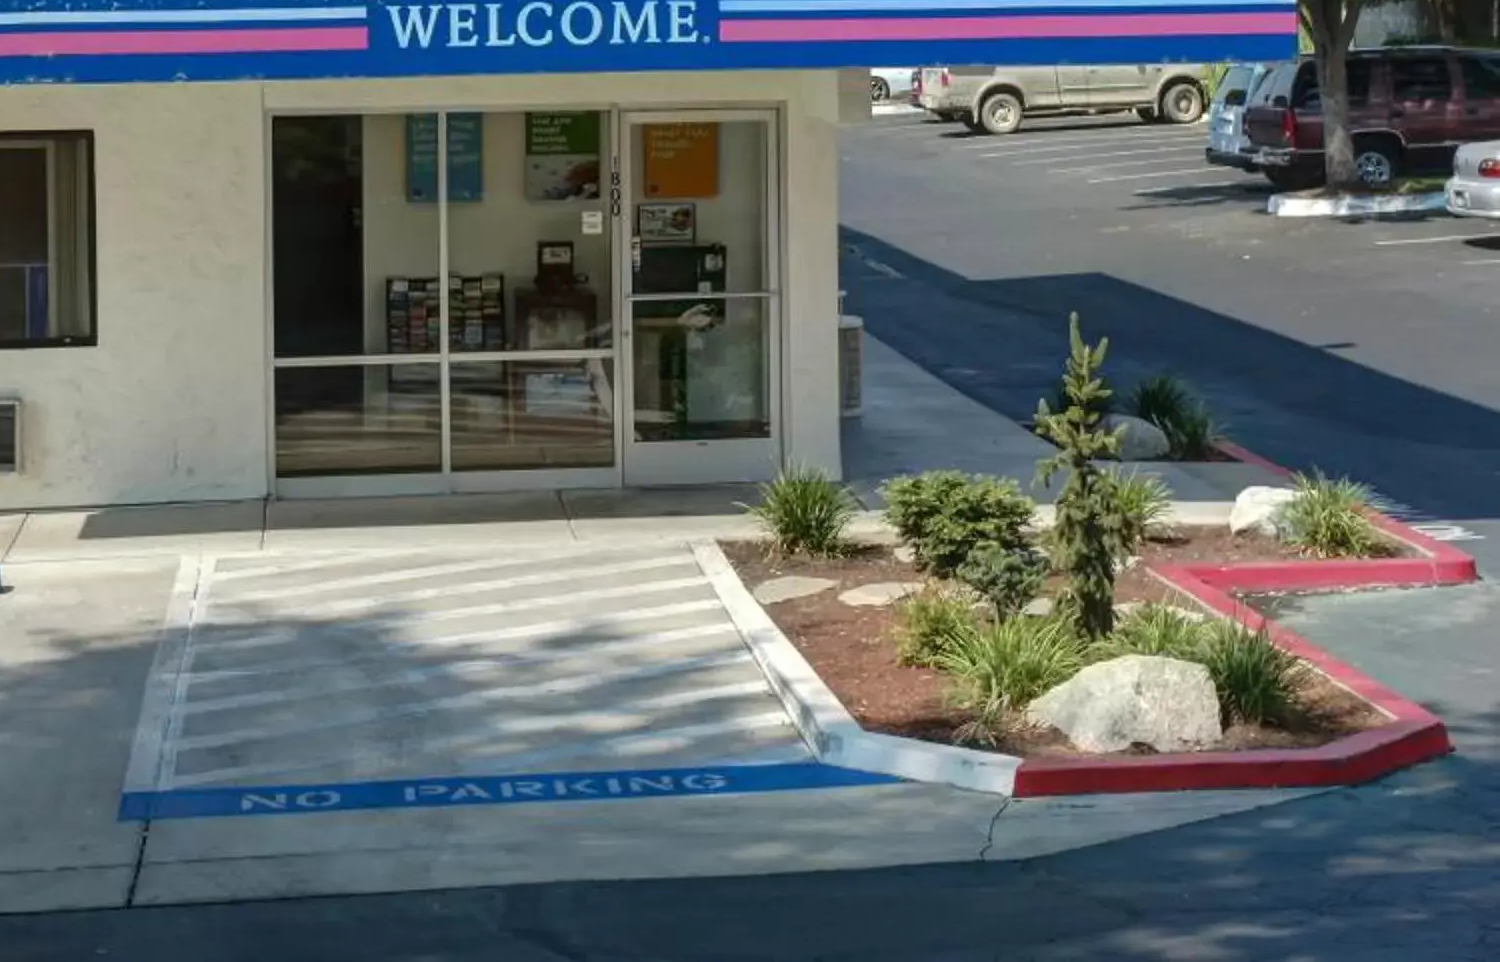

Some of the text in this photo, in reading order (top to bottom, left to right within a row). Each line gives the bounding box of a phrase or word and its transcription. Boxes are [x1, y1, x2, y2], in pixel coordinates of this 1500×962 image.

[386, 0, 711, 49] WELCOME.
[240, 772, 729, 812] NO PARKING
